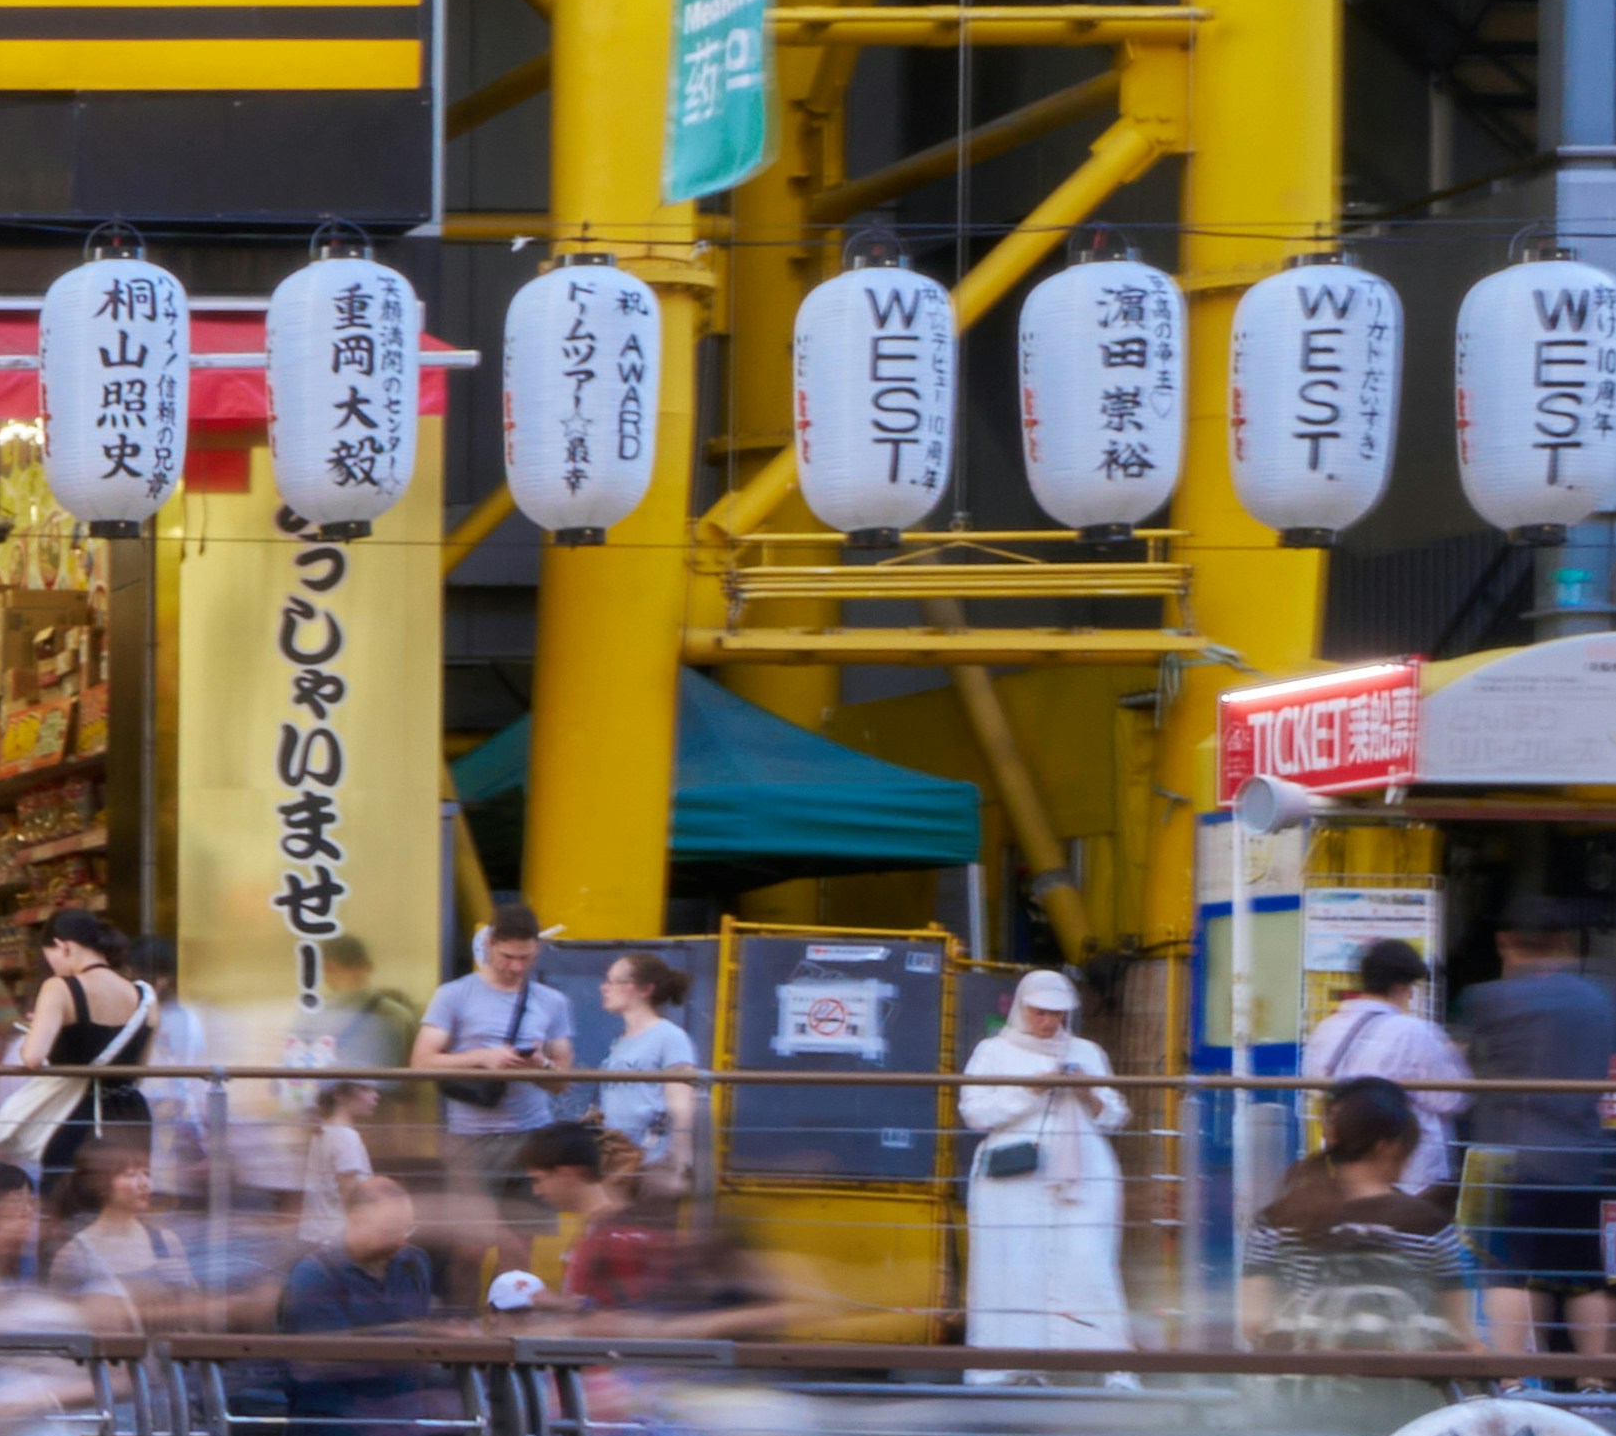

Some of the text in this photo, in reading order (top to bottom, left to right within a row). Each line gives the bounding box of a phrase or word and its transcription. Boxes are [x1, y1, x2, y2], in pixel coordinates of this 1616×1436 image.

[93, 277, 158, 480] 桐山照史
[325, 281, 377, 488] 重岡大毅
[613, 333, 640, 461] AWARD
[864, 286, 924, 486] WEST.
[1293, 284, 1356, 482] WEST.
[1534, 288, 1590, 490] WEST.
[1247, 698, 1348, 779] TICKET
